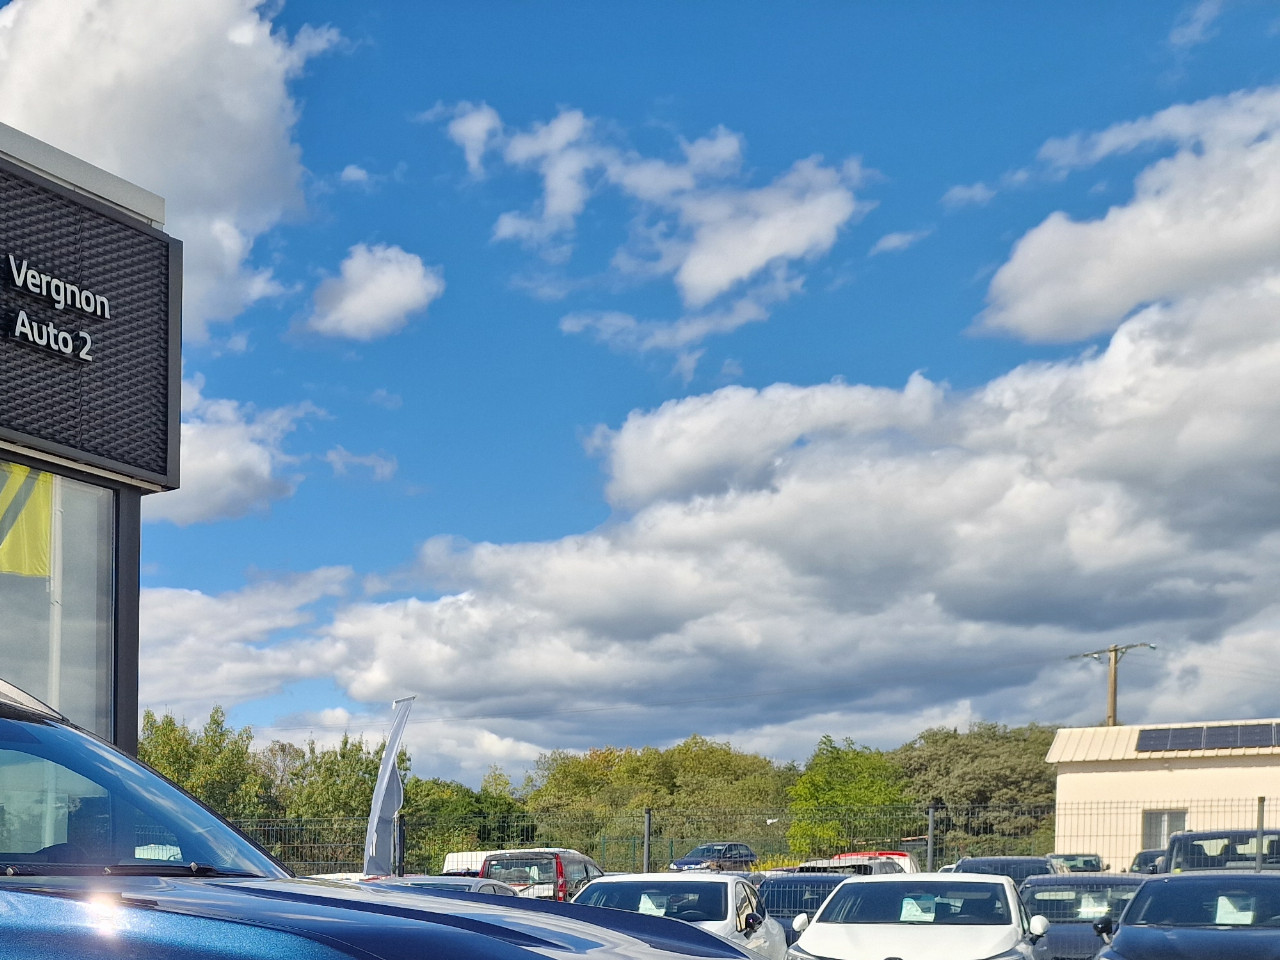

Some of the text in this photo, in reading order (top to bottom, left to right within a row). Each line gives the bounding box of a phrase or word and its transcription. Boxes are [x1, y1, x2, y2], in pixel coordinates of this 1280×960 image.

[8, 254, 110, 320] Vergnon
[15, 310, 93, 362] Auto 2
